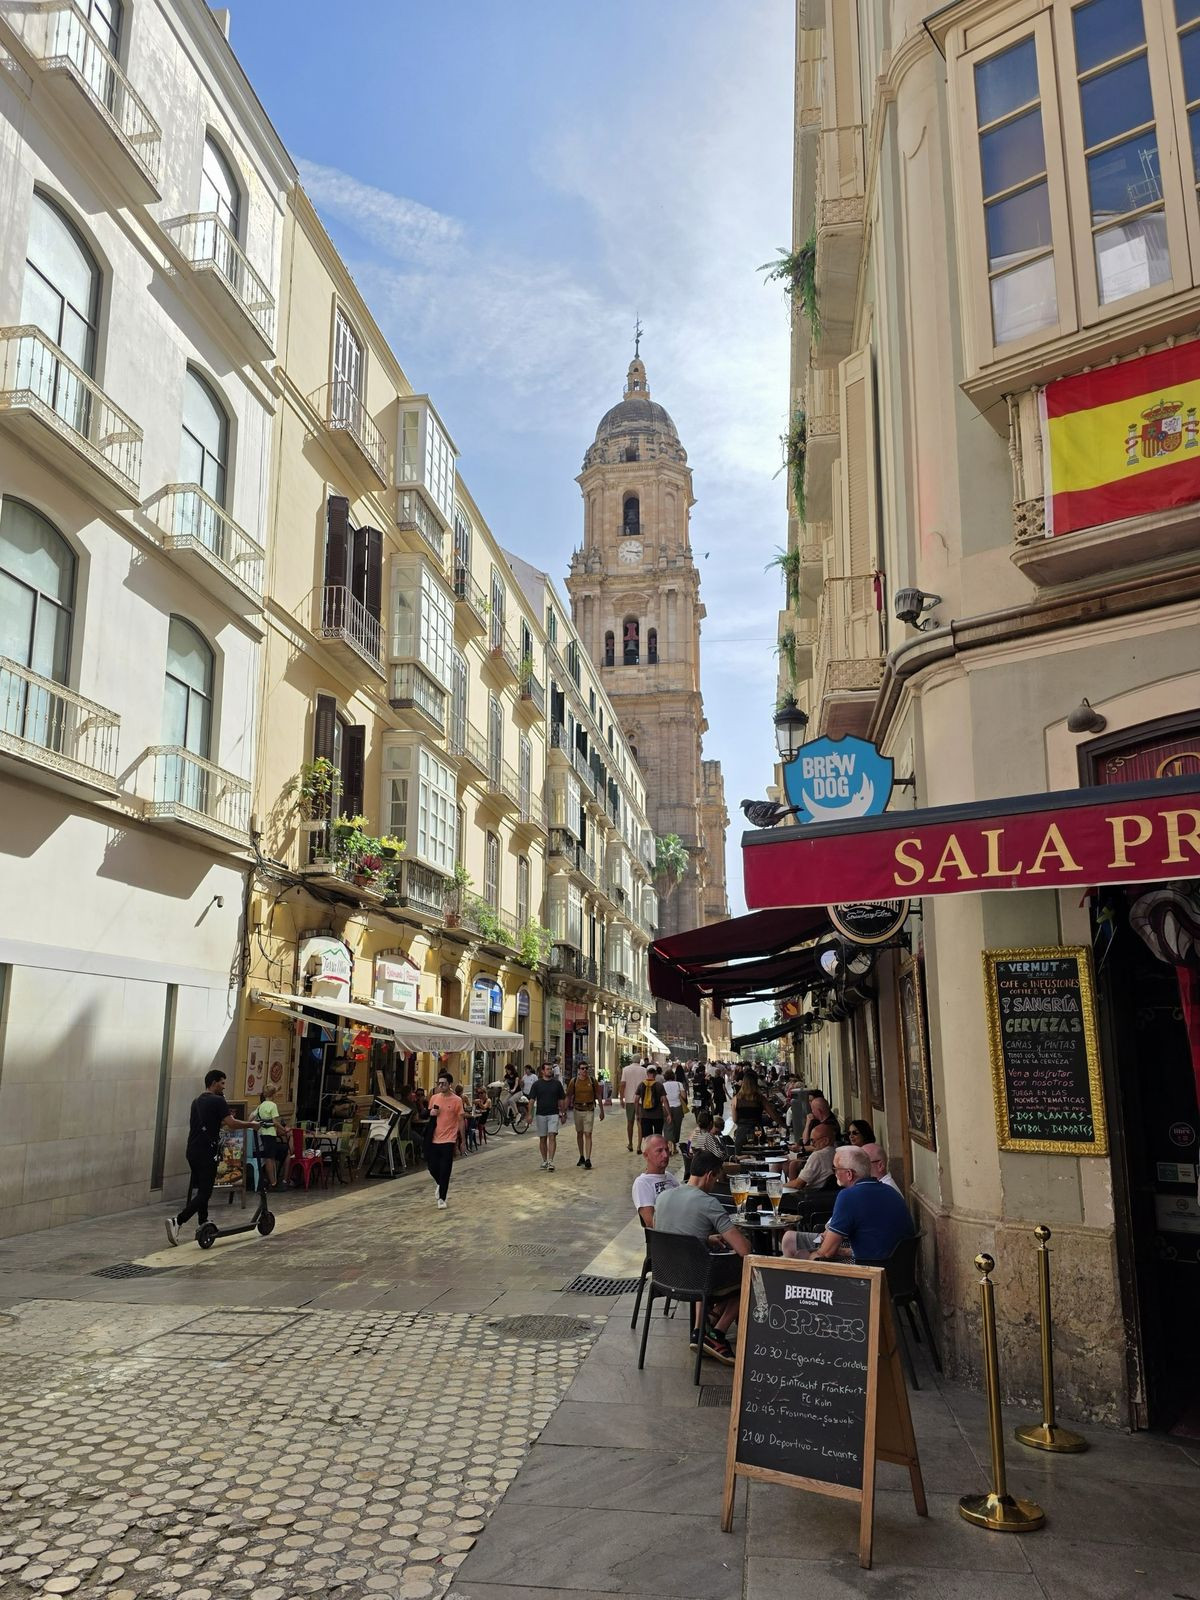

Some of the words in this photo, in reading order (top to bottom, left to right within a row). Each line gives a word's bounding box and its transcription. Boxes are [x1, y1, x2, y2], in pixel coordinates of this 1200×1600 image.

[802, 752, 856, 780] BREW
[813, 775, 850, 800] DOG
[893, 822, 1083, 887] SALA
[1008, 961, 1060, 972] VERMUT
[1030, 979, 1080, 988] INFUSIONES
[1013, 994, 1079, 1012] SANGRÍA
[1005, 1017, 1081, 1033] CERVEZAS
[1044, 1040, 1076, 1049] PINTAS
[1008, 1068, 1022, 1077] Ven
[1033, 1069, 1073, 1080] disfrutar
[1016, 1112, 1033, 1120] DOS
[1037, 1112, 1085, 1121] PLANTAS
[1051, 1124, 1092, 1136] DEPORTES
[785, 1284, 833, 1306] BEEFEATER
[769, 1304, 866, 1343] DEPORTES
[780, 1376, 818, 1390] Eintracht
[801, 1393, 811, 1404] FC
[769, 1433, 812, 1451] Deportivo
[821, 1446, 858, 1461] Levante
